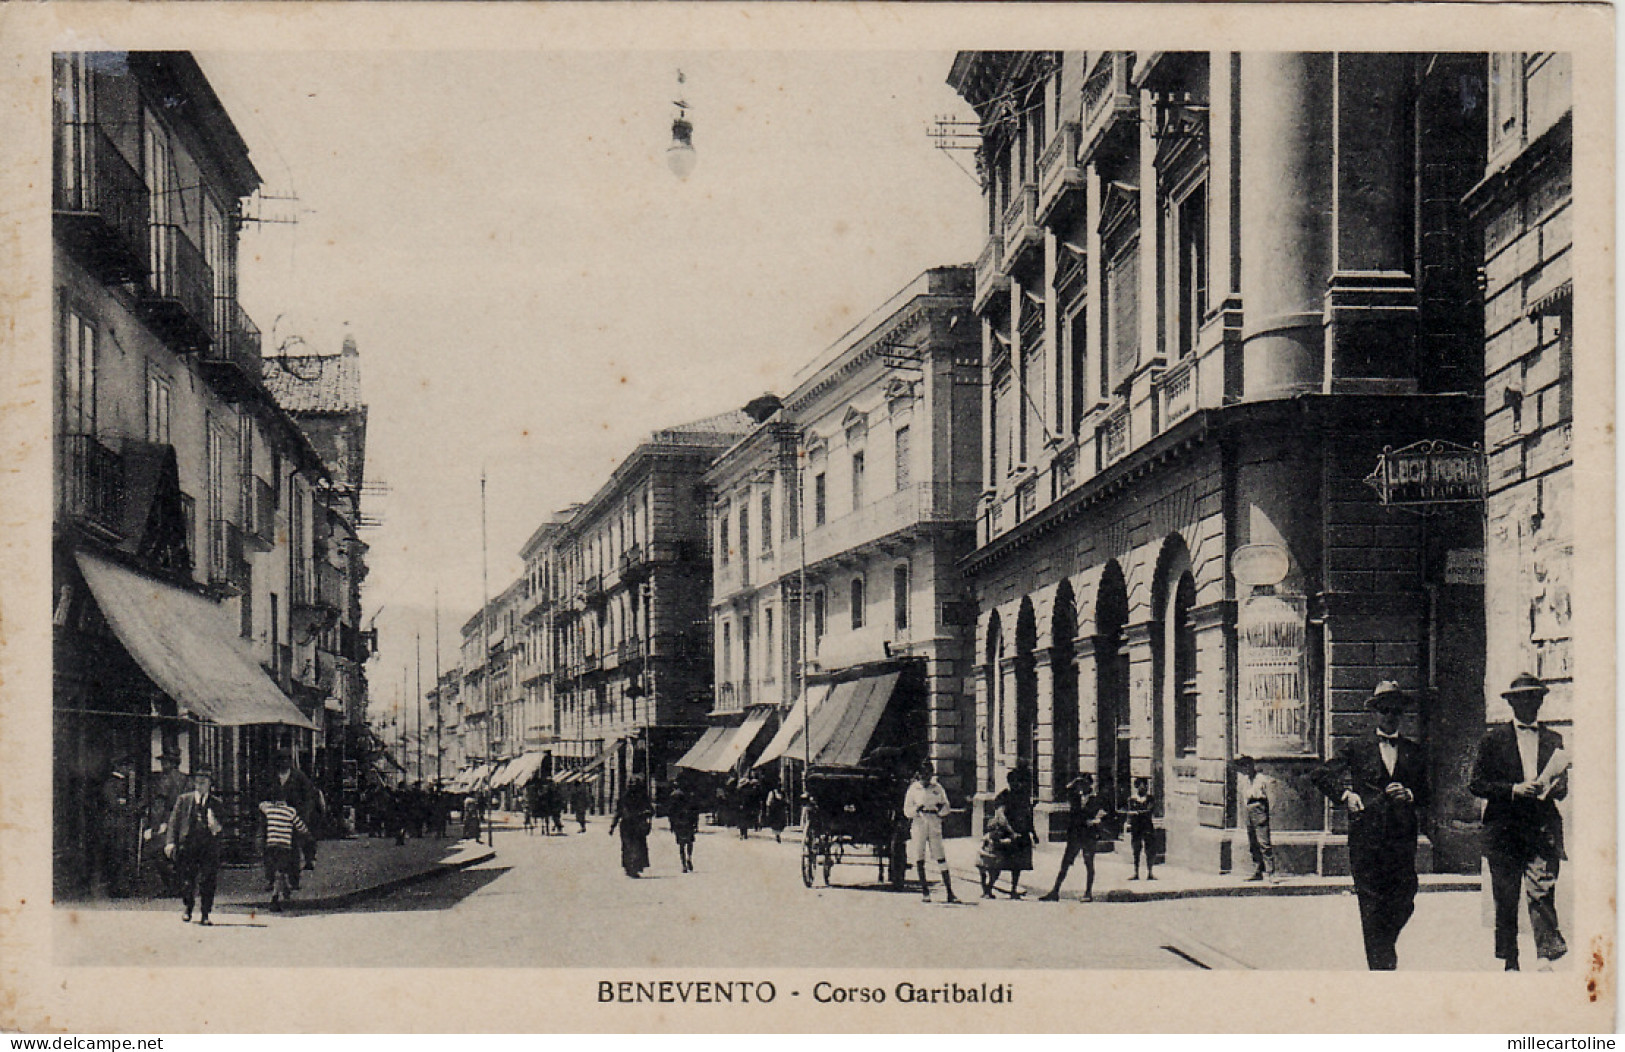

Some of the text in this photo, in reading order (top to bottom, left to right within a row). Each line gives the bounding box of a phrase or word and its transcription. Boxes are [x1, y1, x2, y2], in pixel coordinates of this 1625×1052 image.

[597, 980, 777, 1003] BENEVENTO
[812, 981, 886, 1004] Corso
[894, 982, 1012, 1004] Garibaldi
